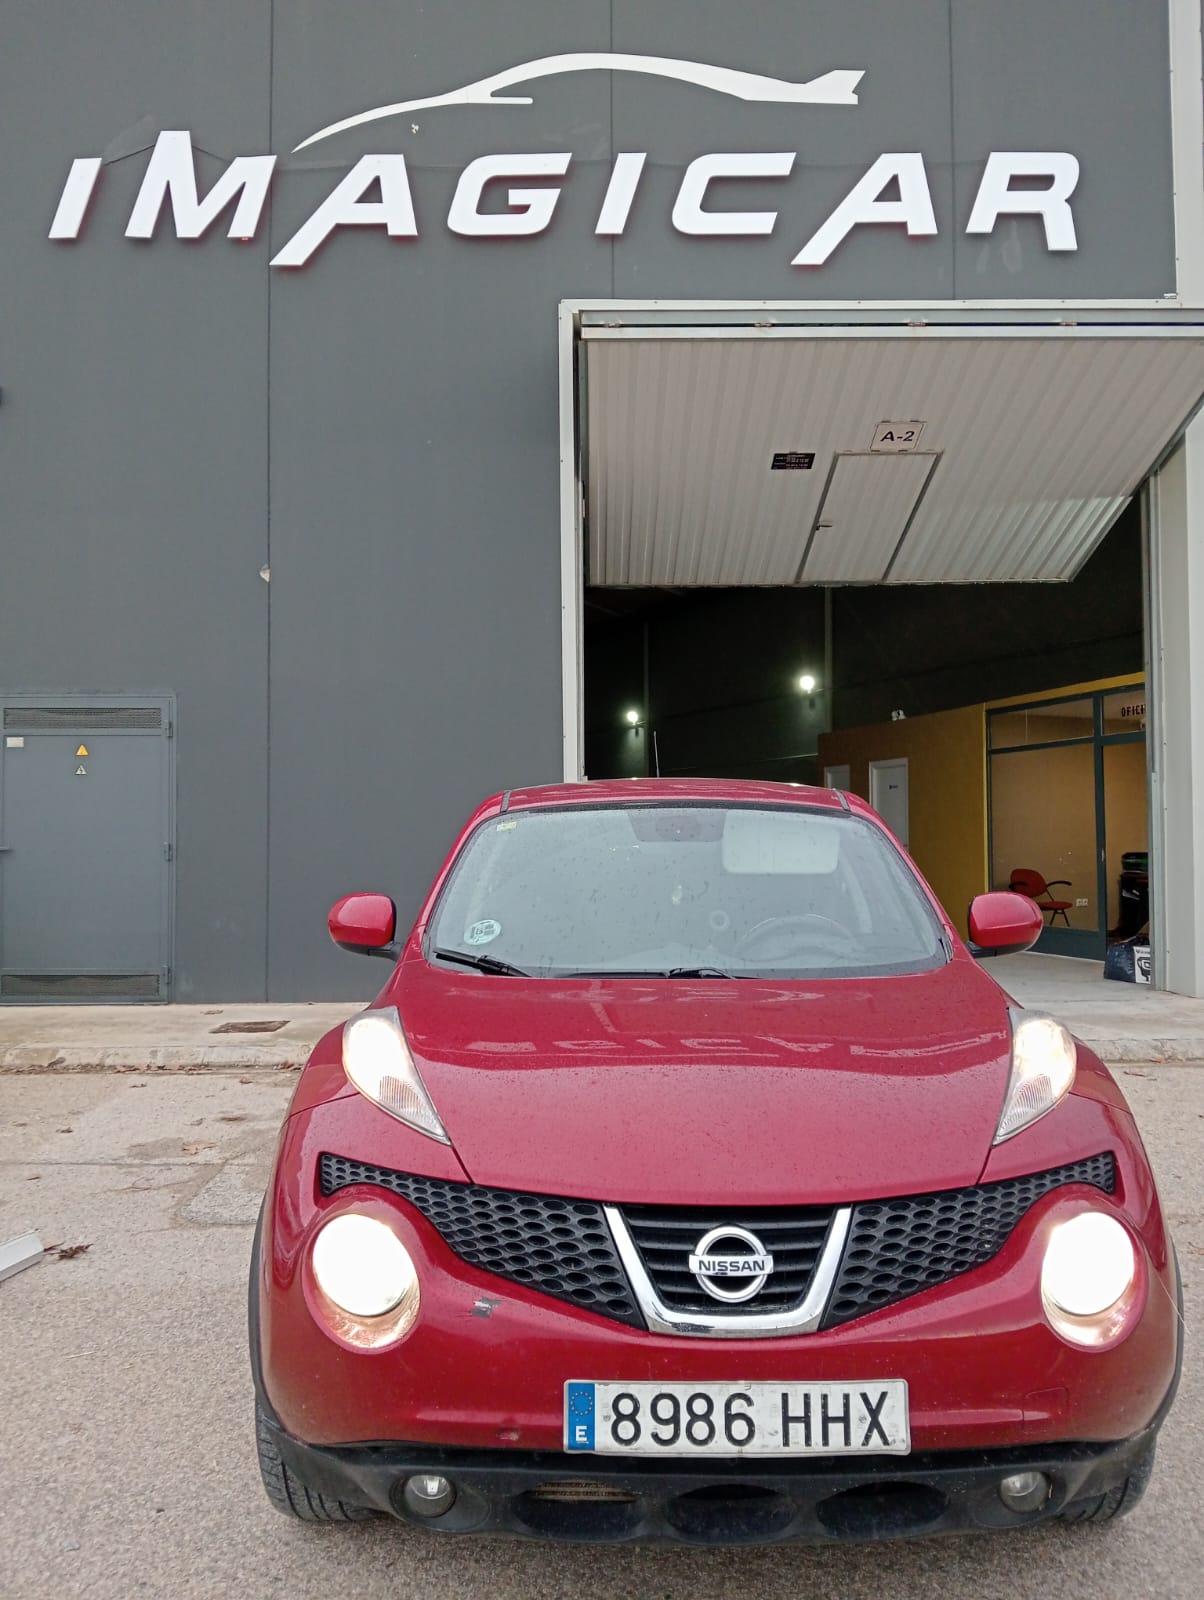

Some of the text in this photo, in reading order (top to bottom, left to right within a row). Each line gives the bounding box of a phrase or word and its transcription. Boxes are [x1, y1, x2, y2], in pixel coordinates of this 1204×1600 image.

[48, 130, 1080, 267] IMAGICAR
[880, 431, 915, 442] A-2
[1121, 704, 1146, 717] OFICI
[698, 1258, 766, 1274] NISSAN
[575, 1390, 890, 1448] E 8986 HHX
